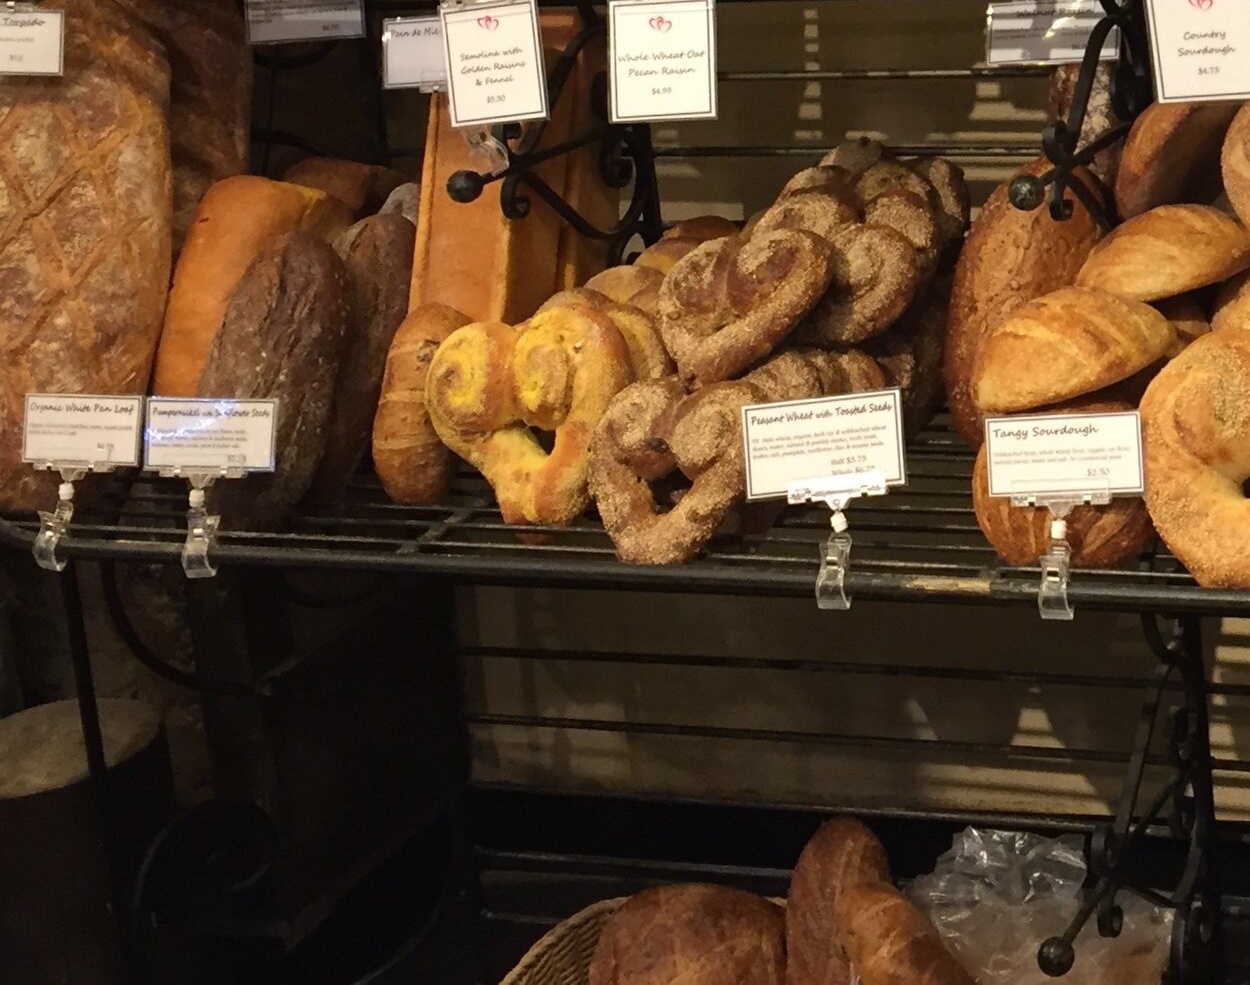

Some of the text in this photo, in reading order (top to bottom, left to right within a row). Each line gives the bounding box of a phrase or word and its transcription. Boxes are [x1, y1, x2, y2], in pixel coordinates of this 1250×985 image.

[1183, 30, 1226, 41] Country
[502, 47, 523, 57] with
[618, 49, 706, 63] Whole Wheat Oat
[1177, 45, 1236, 57] Sourdough
[460, 61, 526, 75] Golden Raisins
[628, 66, 696, 77] Pecan Raisin
[485, 75, 514, 85] Fennel
[29, 401, 134, 416] Organic White Pan Loaf
[750, 400, 893, 426] Peasant Wheat with Toasted Seeds
[992, 423, 1100, 440] Tangy Sourdough
